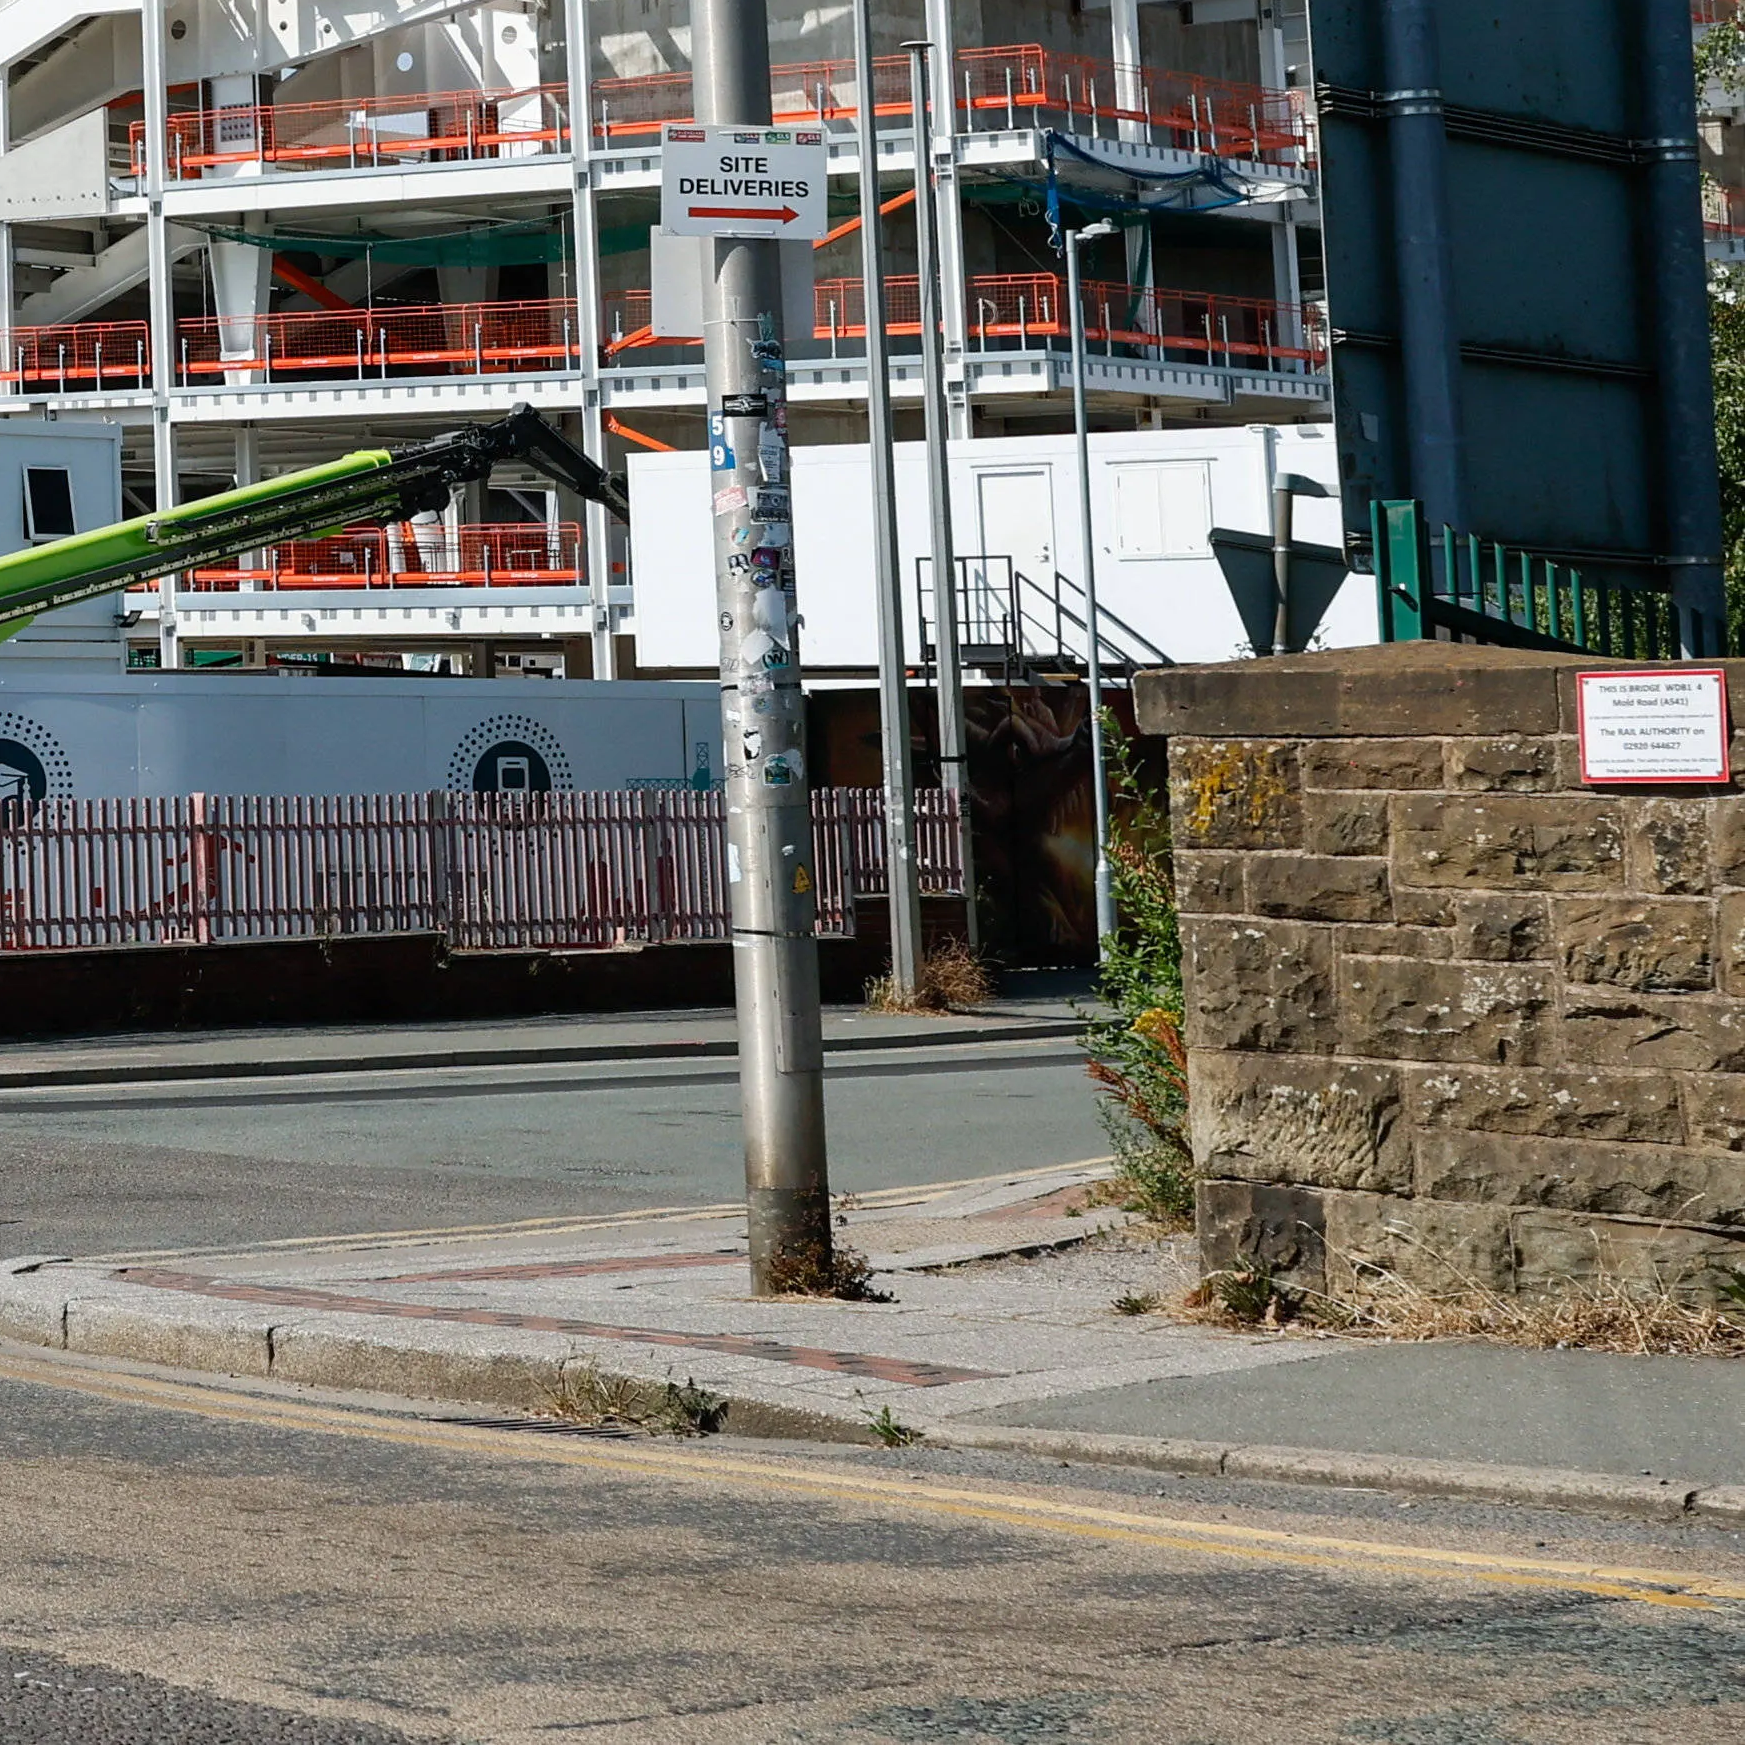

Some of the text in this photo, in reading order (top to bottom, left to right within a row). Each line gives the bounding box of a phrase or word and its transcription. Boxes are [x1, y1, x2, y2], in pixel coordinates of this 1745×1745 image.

[720, 156, 768, 174] SITE
[679, 178, 809, 197] DELIVERIES
[712, 415, 723, 435] 5
[713, 445, 725, 466] 9
[1599, 685, 1617, 693] THIS
[1629, 684, 1661, 692] BRIDGE
[1637, 698, 1658, 706] Road
[1639, 727, 1690, 735] AUTHORITY
